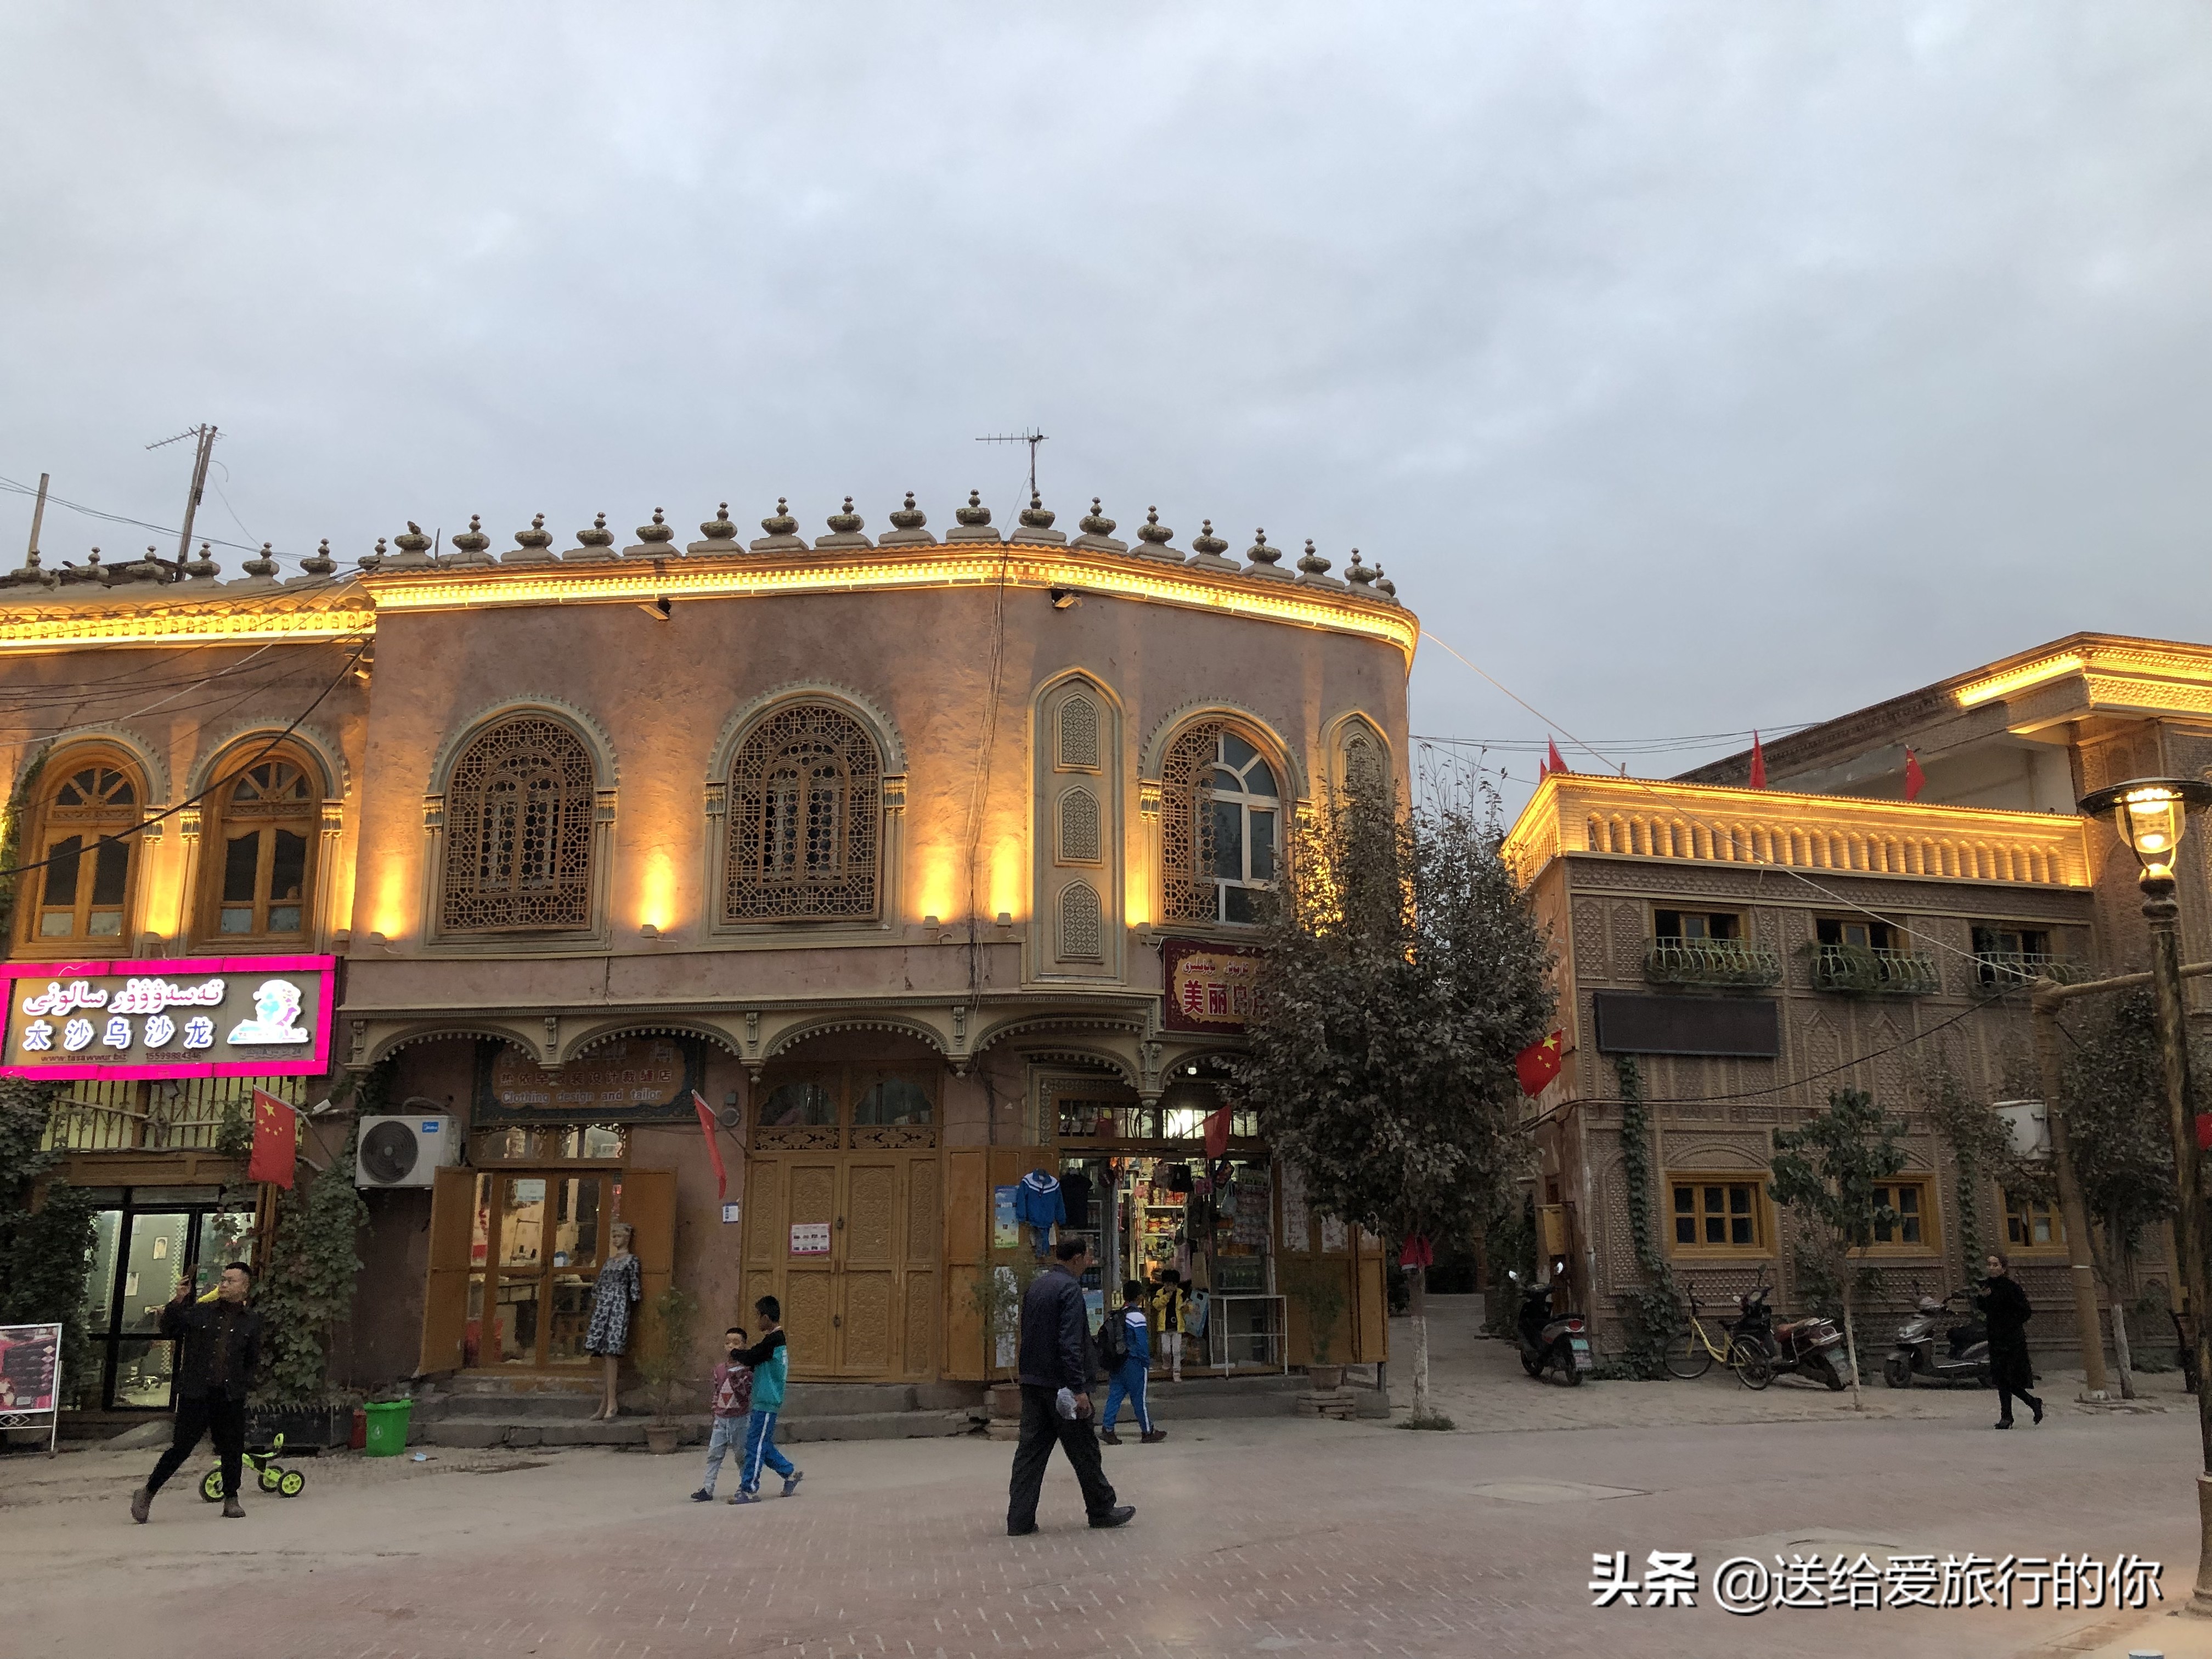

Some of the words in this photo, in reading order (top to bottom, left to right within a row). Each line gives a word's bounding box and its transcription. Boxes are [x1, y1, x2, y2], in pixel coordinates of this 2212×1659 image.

[23, 1016, 213, 1051] 太沙乌沙龙
[501, 1091, 550, 1104] Clothing
[556, 1090, 595, 1103] design
[601, 1088, 623, 1101] and
[630, 1088, 662, 1101] tailor
